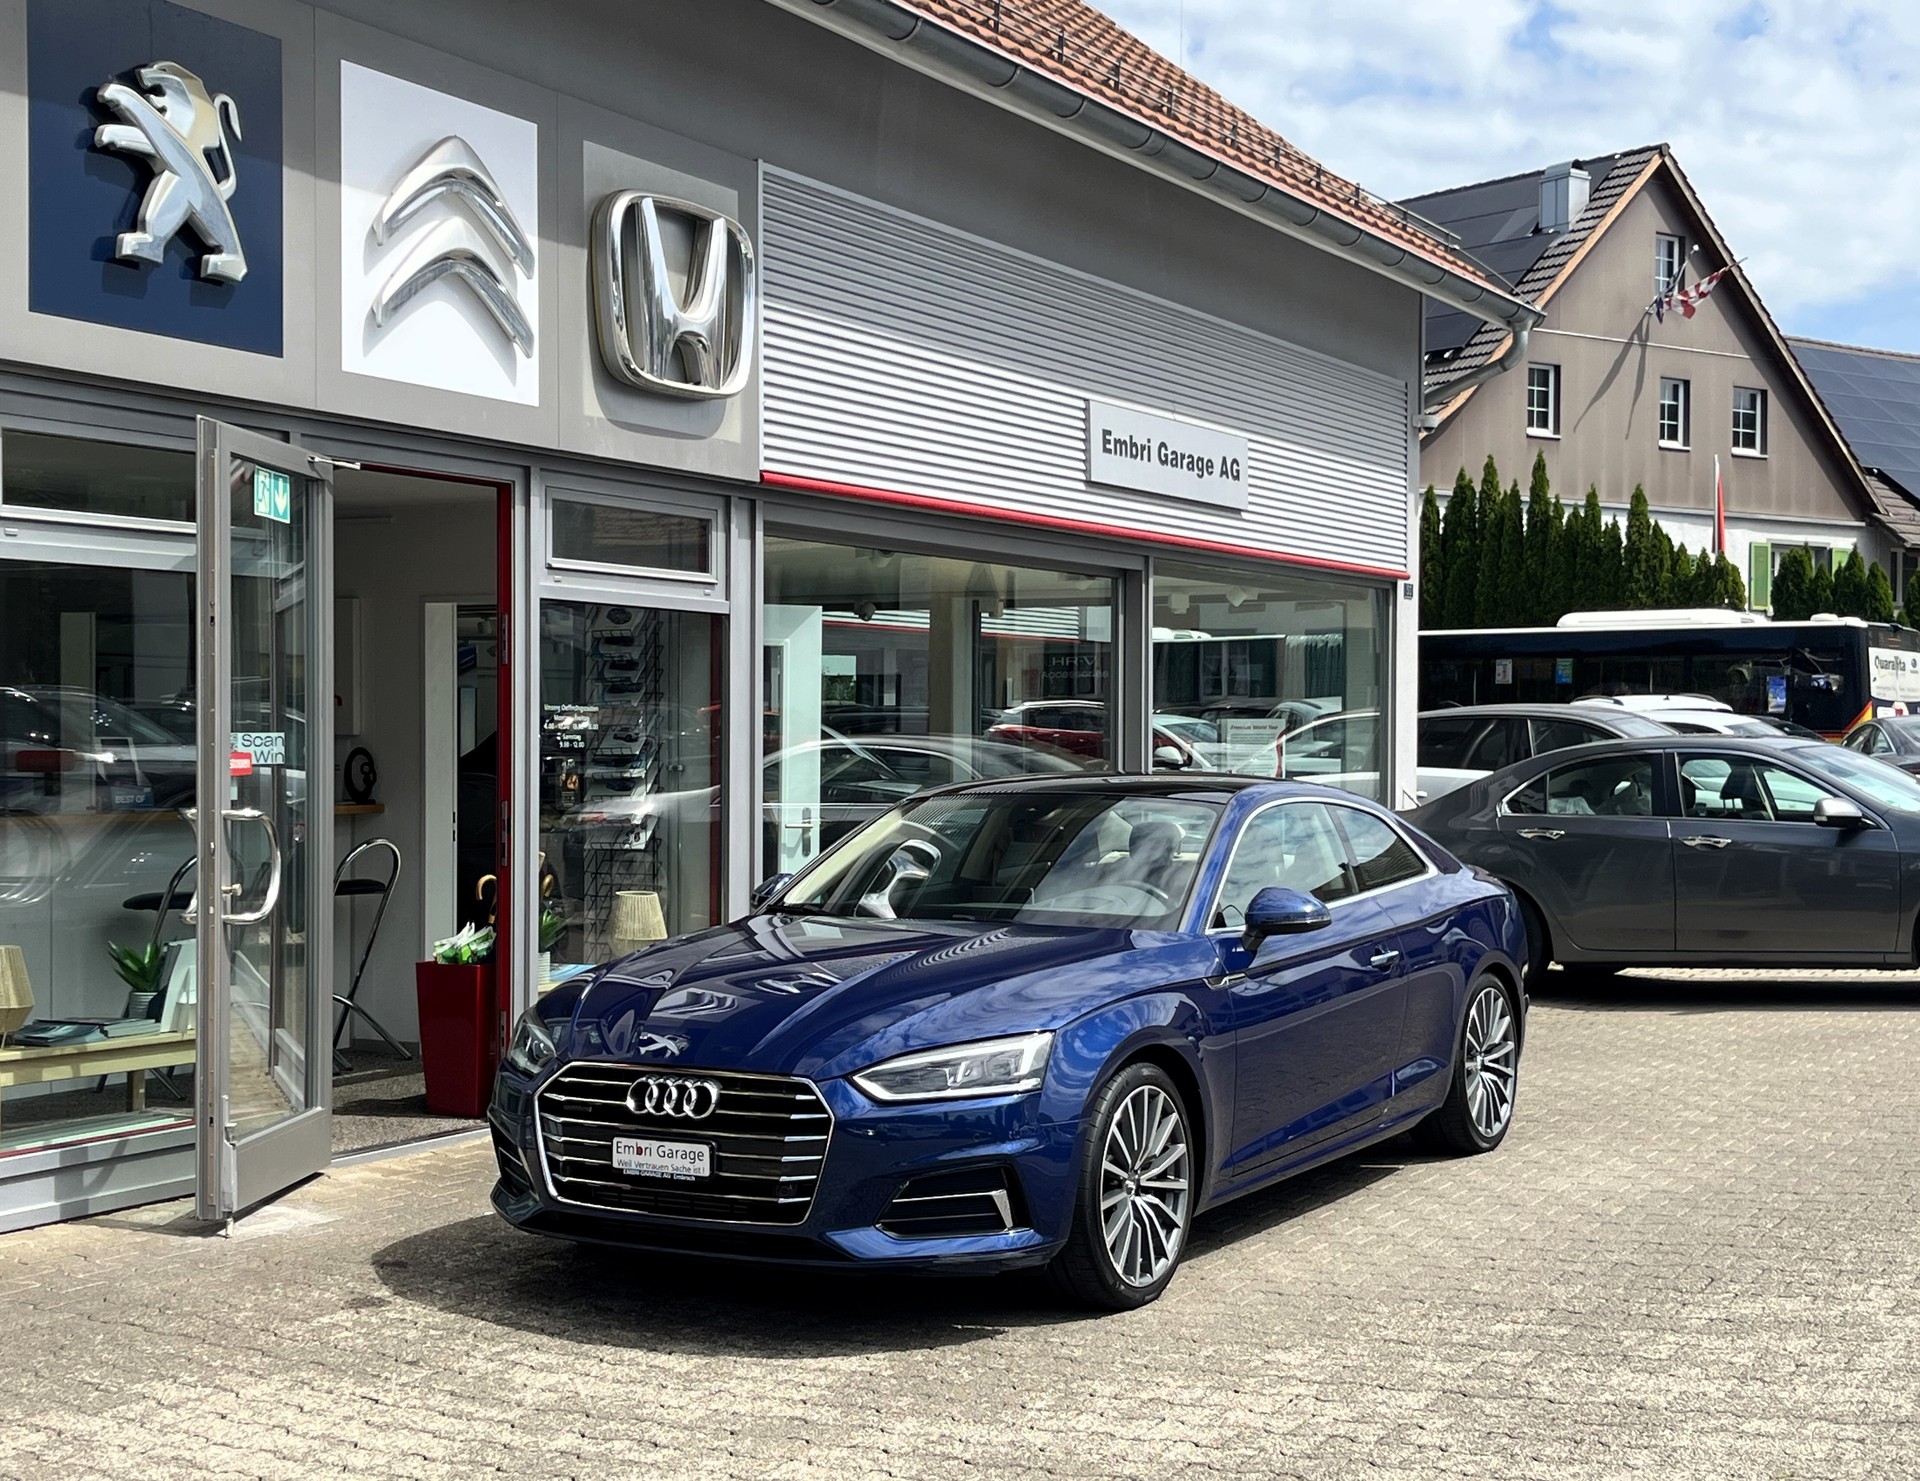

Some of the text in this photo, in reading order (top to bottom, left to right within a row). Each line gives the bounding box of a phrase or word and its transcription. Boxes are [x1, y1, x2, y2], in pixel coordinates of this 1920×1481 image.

[1102, 429, 1241, 481] Embri Garage AG
[241, 733, 285, 748] Scan
[253, 748, 285, 764] Win
[616, 1140, 705, 1164] Embri Garage
[617, 1159, 633, 1168] Weil
[633, 1160, 669, 1171] Vertrauen
[670, 1163, 692, 1173] Sache
